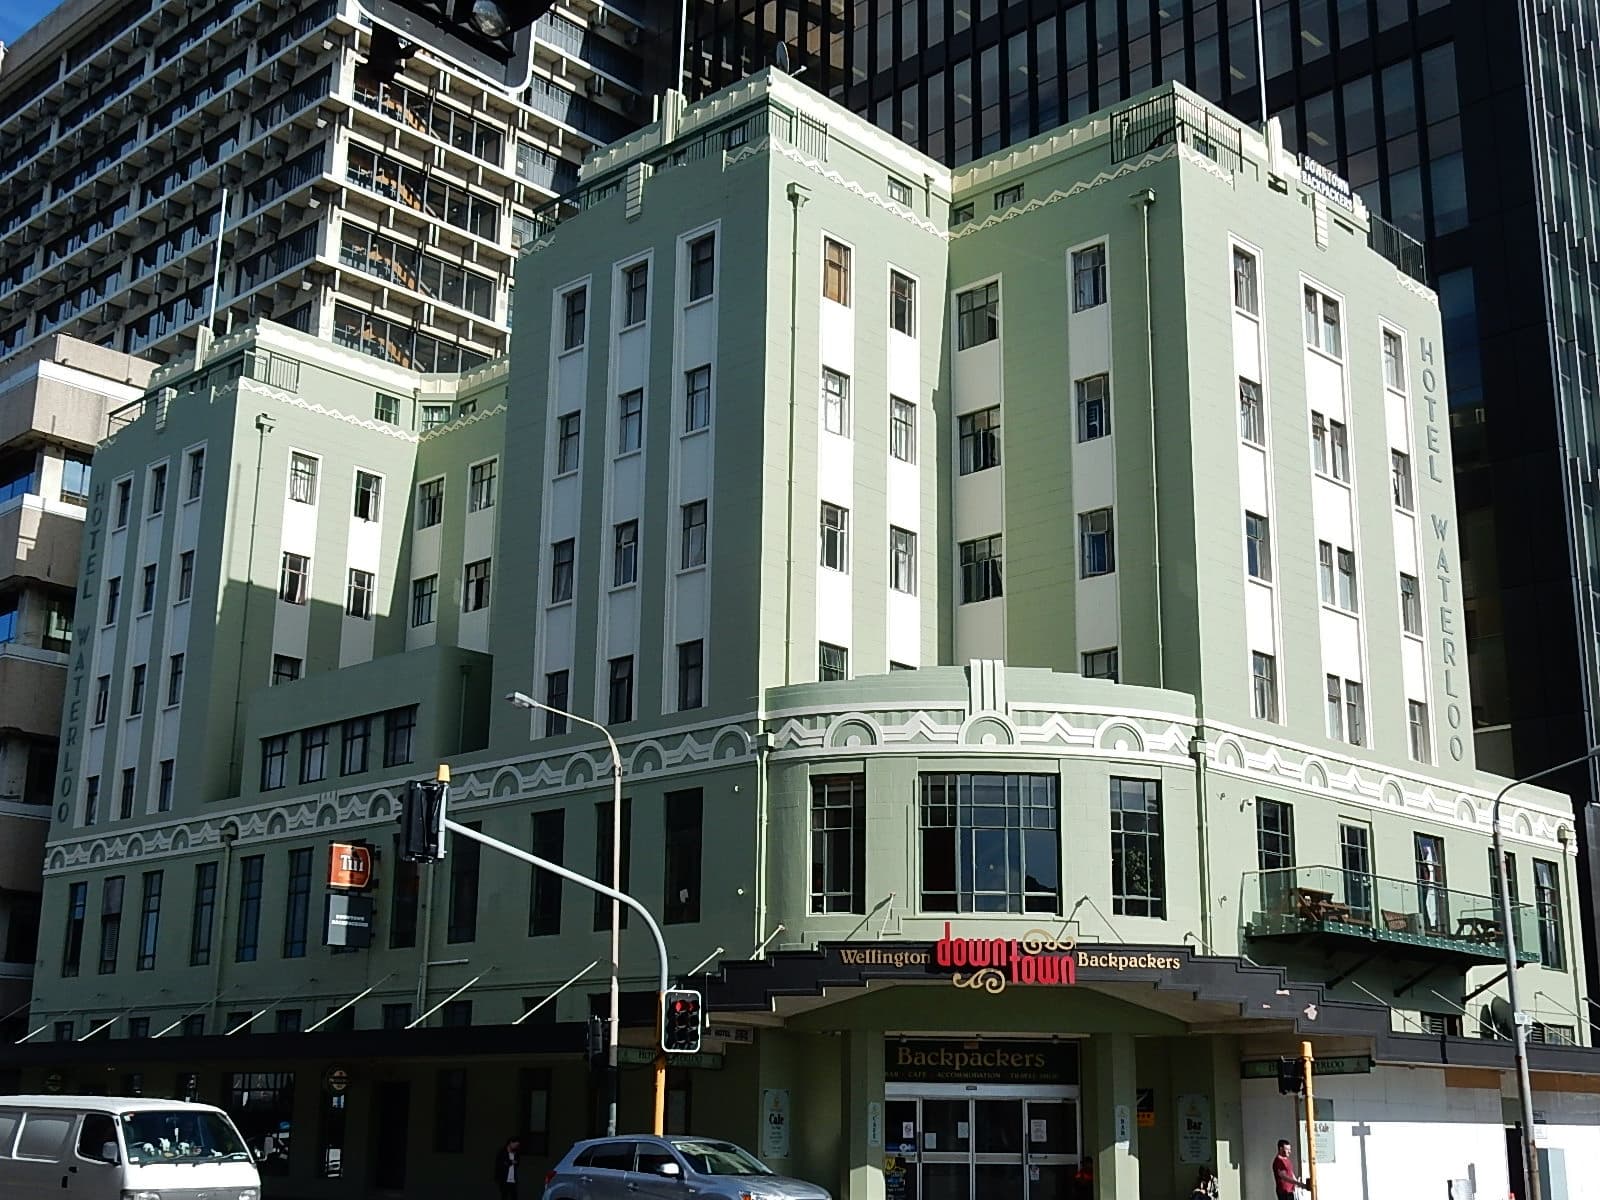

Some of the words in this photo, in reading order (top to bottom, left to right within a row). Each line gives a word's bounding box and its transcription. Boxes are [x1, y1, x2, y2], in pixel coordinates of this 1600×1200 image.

[1301, 170, 1353, 213] BACKPACKERS
[82, 481, 105, 601] HOTEL
[1420, 336, 1442, 483] HOTEL
[1431, 514, 1463, 762] WATERLOO
[57, 625, 90, 825] WATERLOO
[840, 949, 931, 967] Wellington
[1077, 951, 1181, 971] Backpackers
[897, 1046, 1046, 1071] Backpackers
